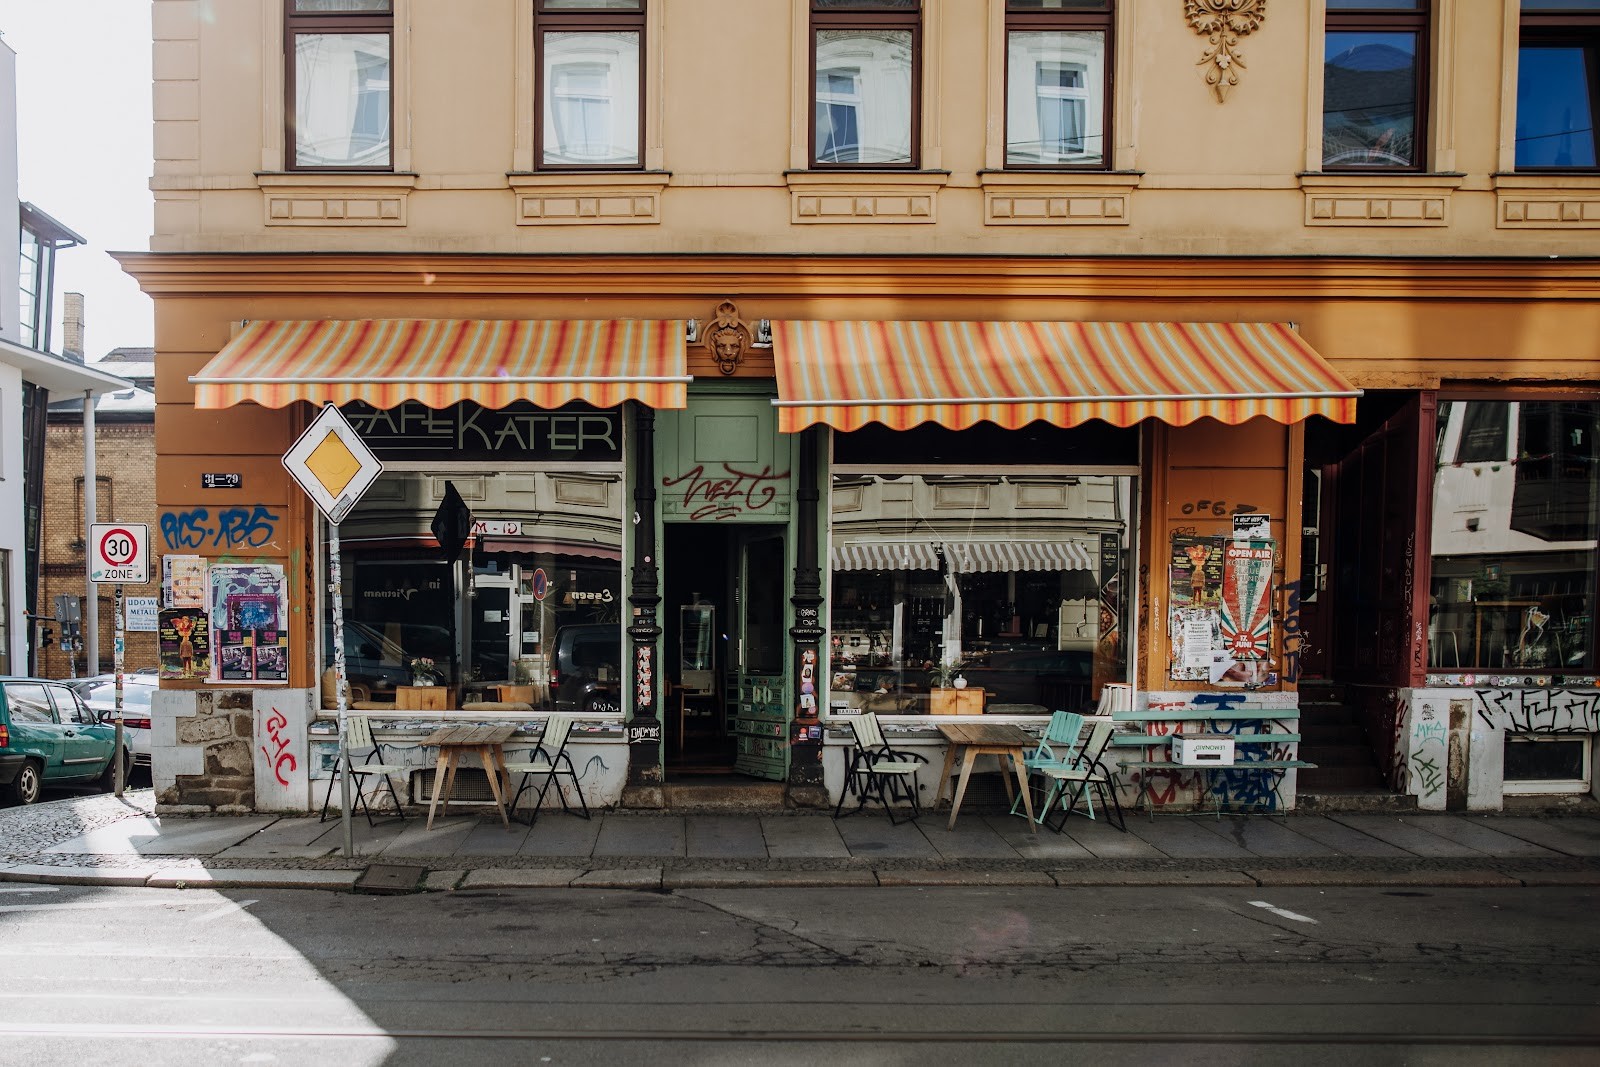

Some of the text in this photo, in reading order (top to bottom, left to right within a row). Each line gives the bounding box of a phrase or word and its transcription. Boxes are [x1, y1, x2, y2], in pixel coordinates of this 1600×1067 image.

[458, 401, 617, 450] KATER
[107, 539, 130, 557] 30
[1228, 549, 1271, 559] OPEN AIR
[104, 569, 133, 579] ZONE
[1231, 574, 1265, 583] STUNDE
